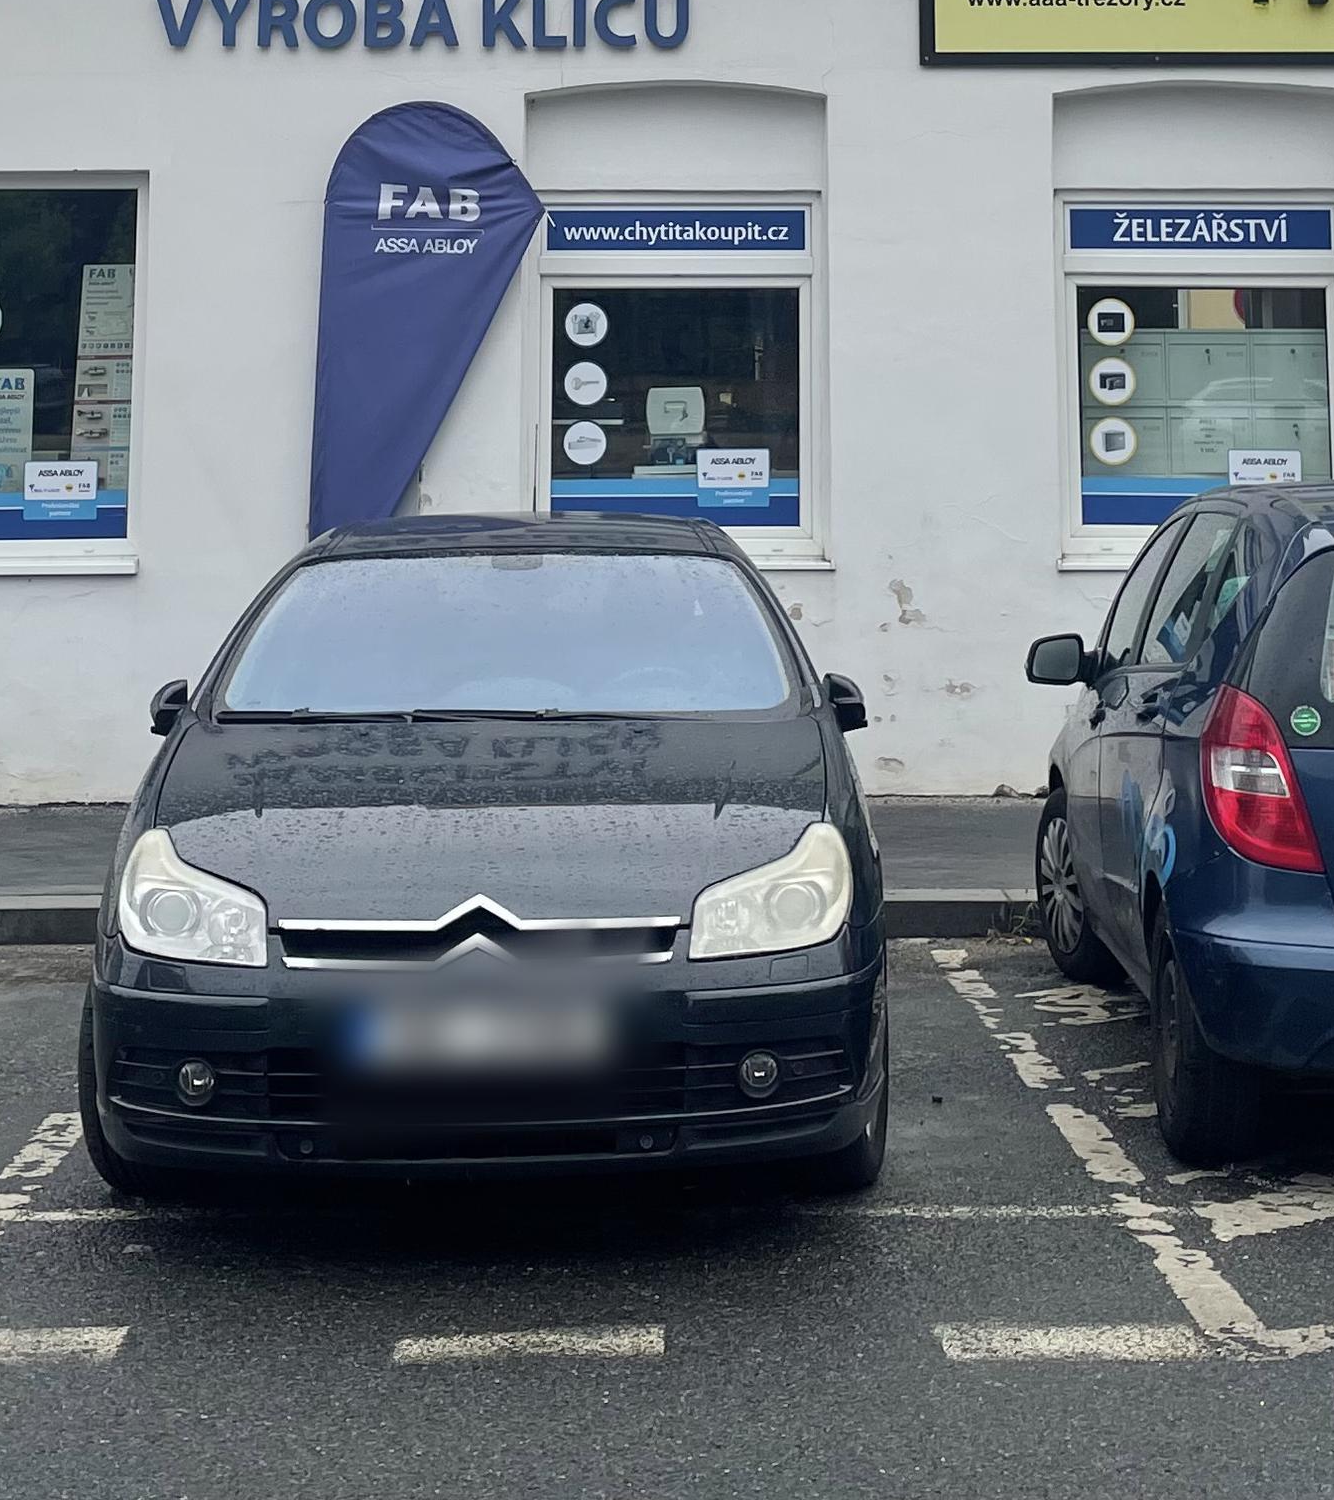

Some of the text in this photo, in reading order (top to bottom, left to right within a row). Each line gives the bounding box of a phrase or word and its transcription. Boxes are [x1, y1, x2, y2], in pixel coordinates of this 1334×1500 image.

[378, 182, 482, 222] FAB
[563, 220, 790, 246] www.chytitakoupit.cz
[1112, 212, 1288, 243] ŽELEZÁŘSTVÍ
[374, 238, 480, 255] ASSA ABLOY
